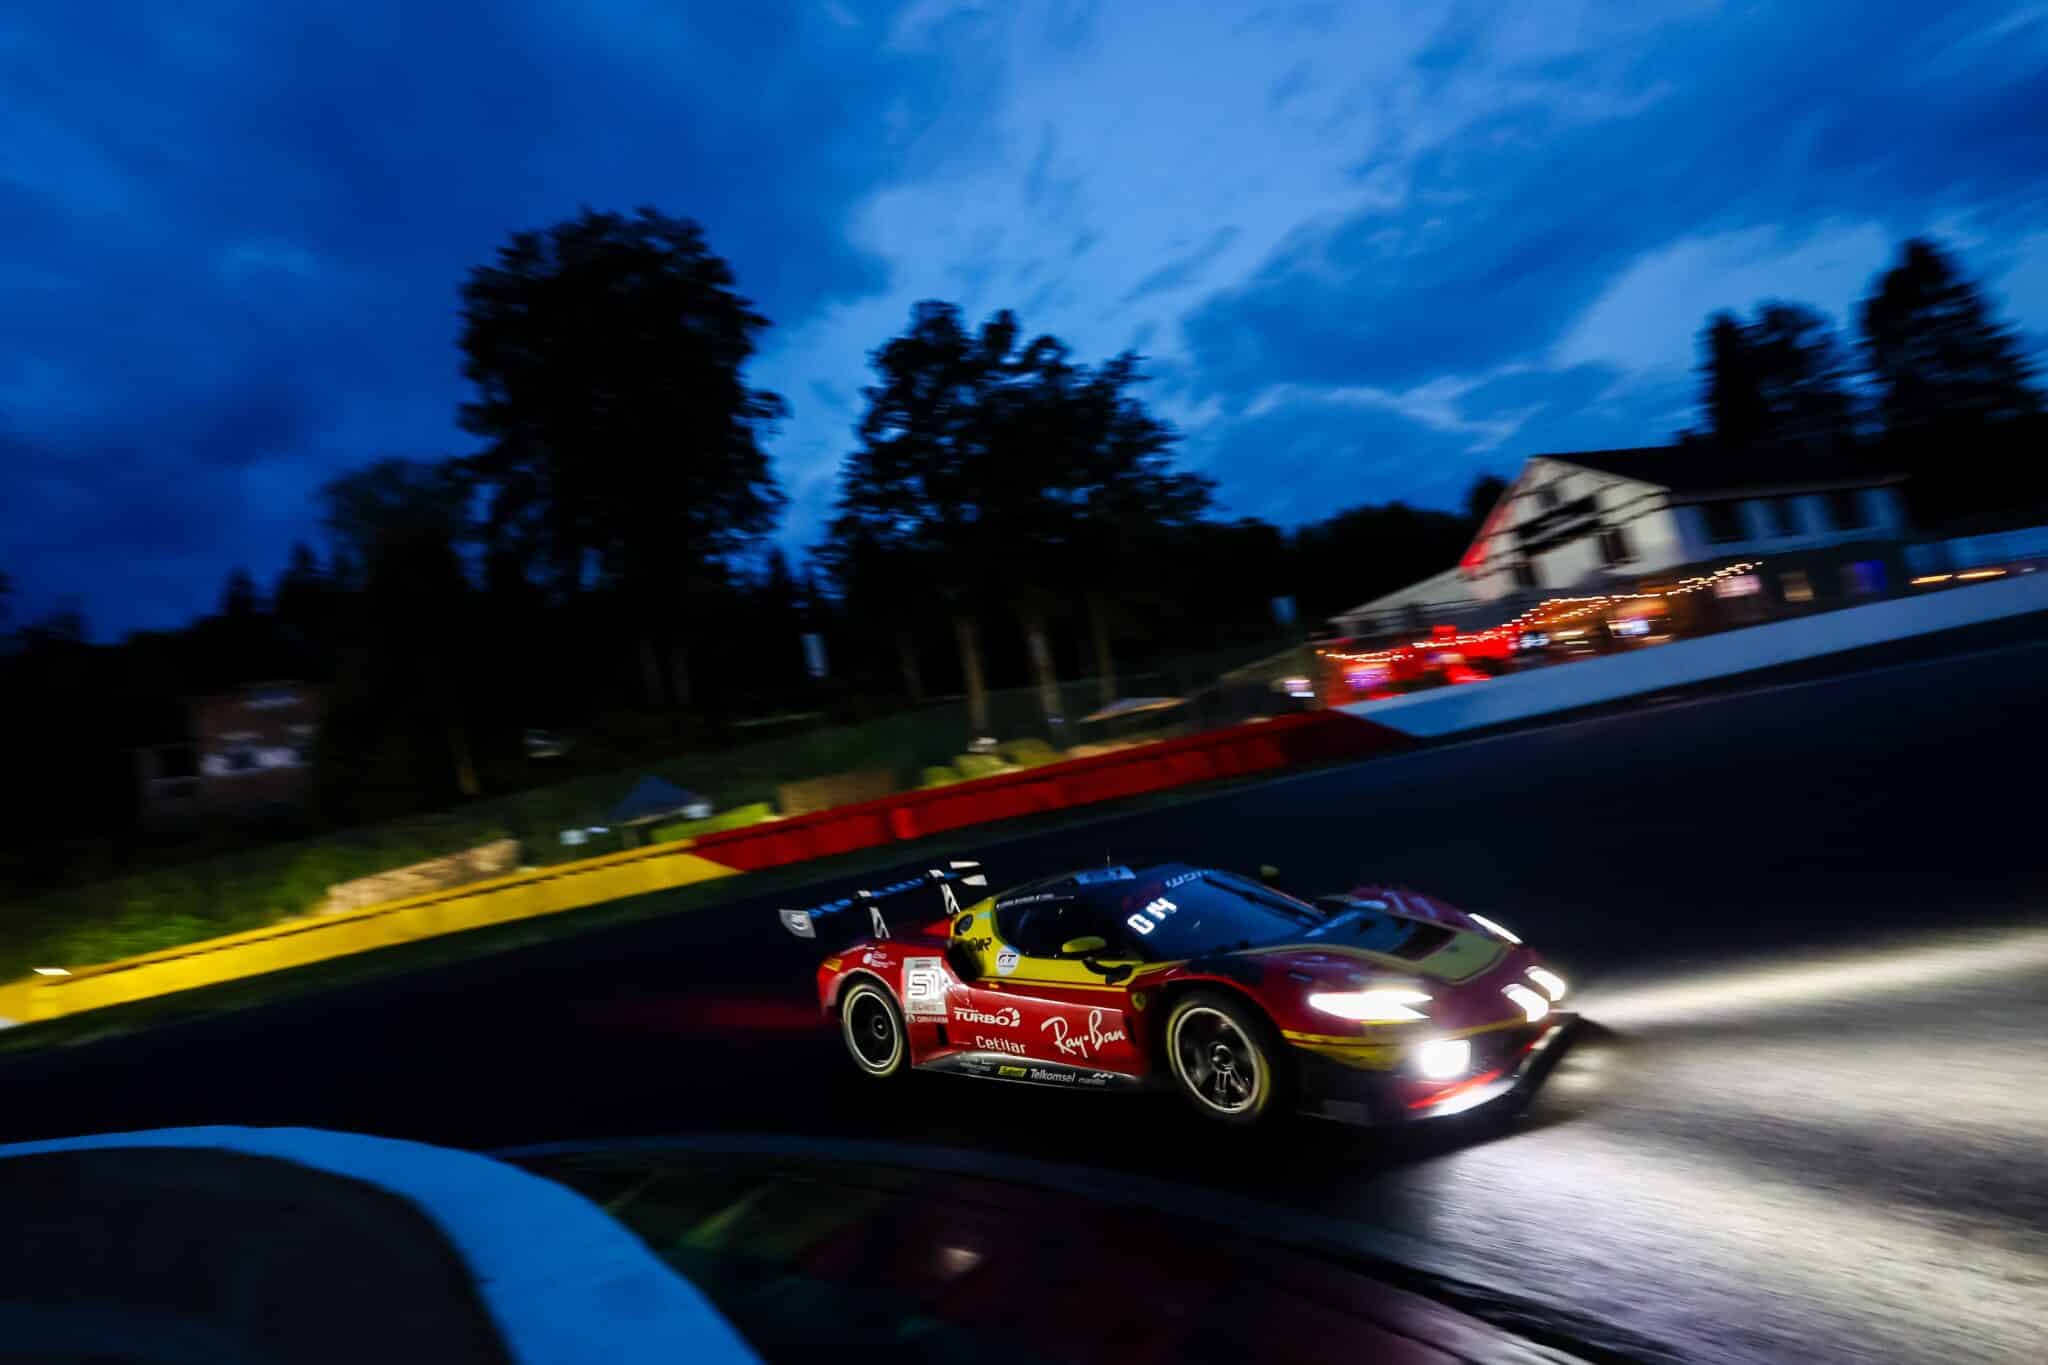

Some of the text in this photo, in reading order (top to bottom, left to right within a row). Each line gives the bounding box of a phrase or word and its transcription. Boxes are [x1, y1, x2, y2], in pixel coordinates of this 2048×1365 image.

[907, 967, 943, 1000] 51
[975, 1035, 1027, 1055] Cetilar
[1030, 1068, 1076, 1082] Telkomsel
